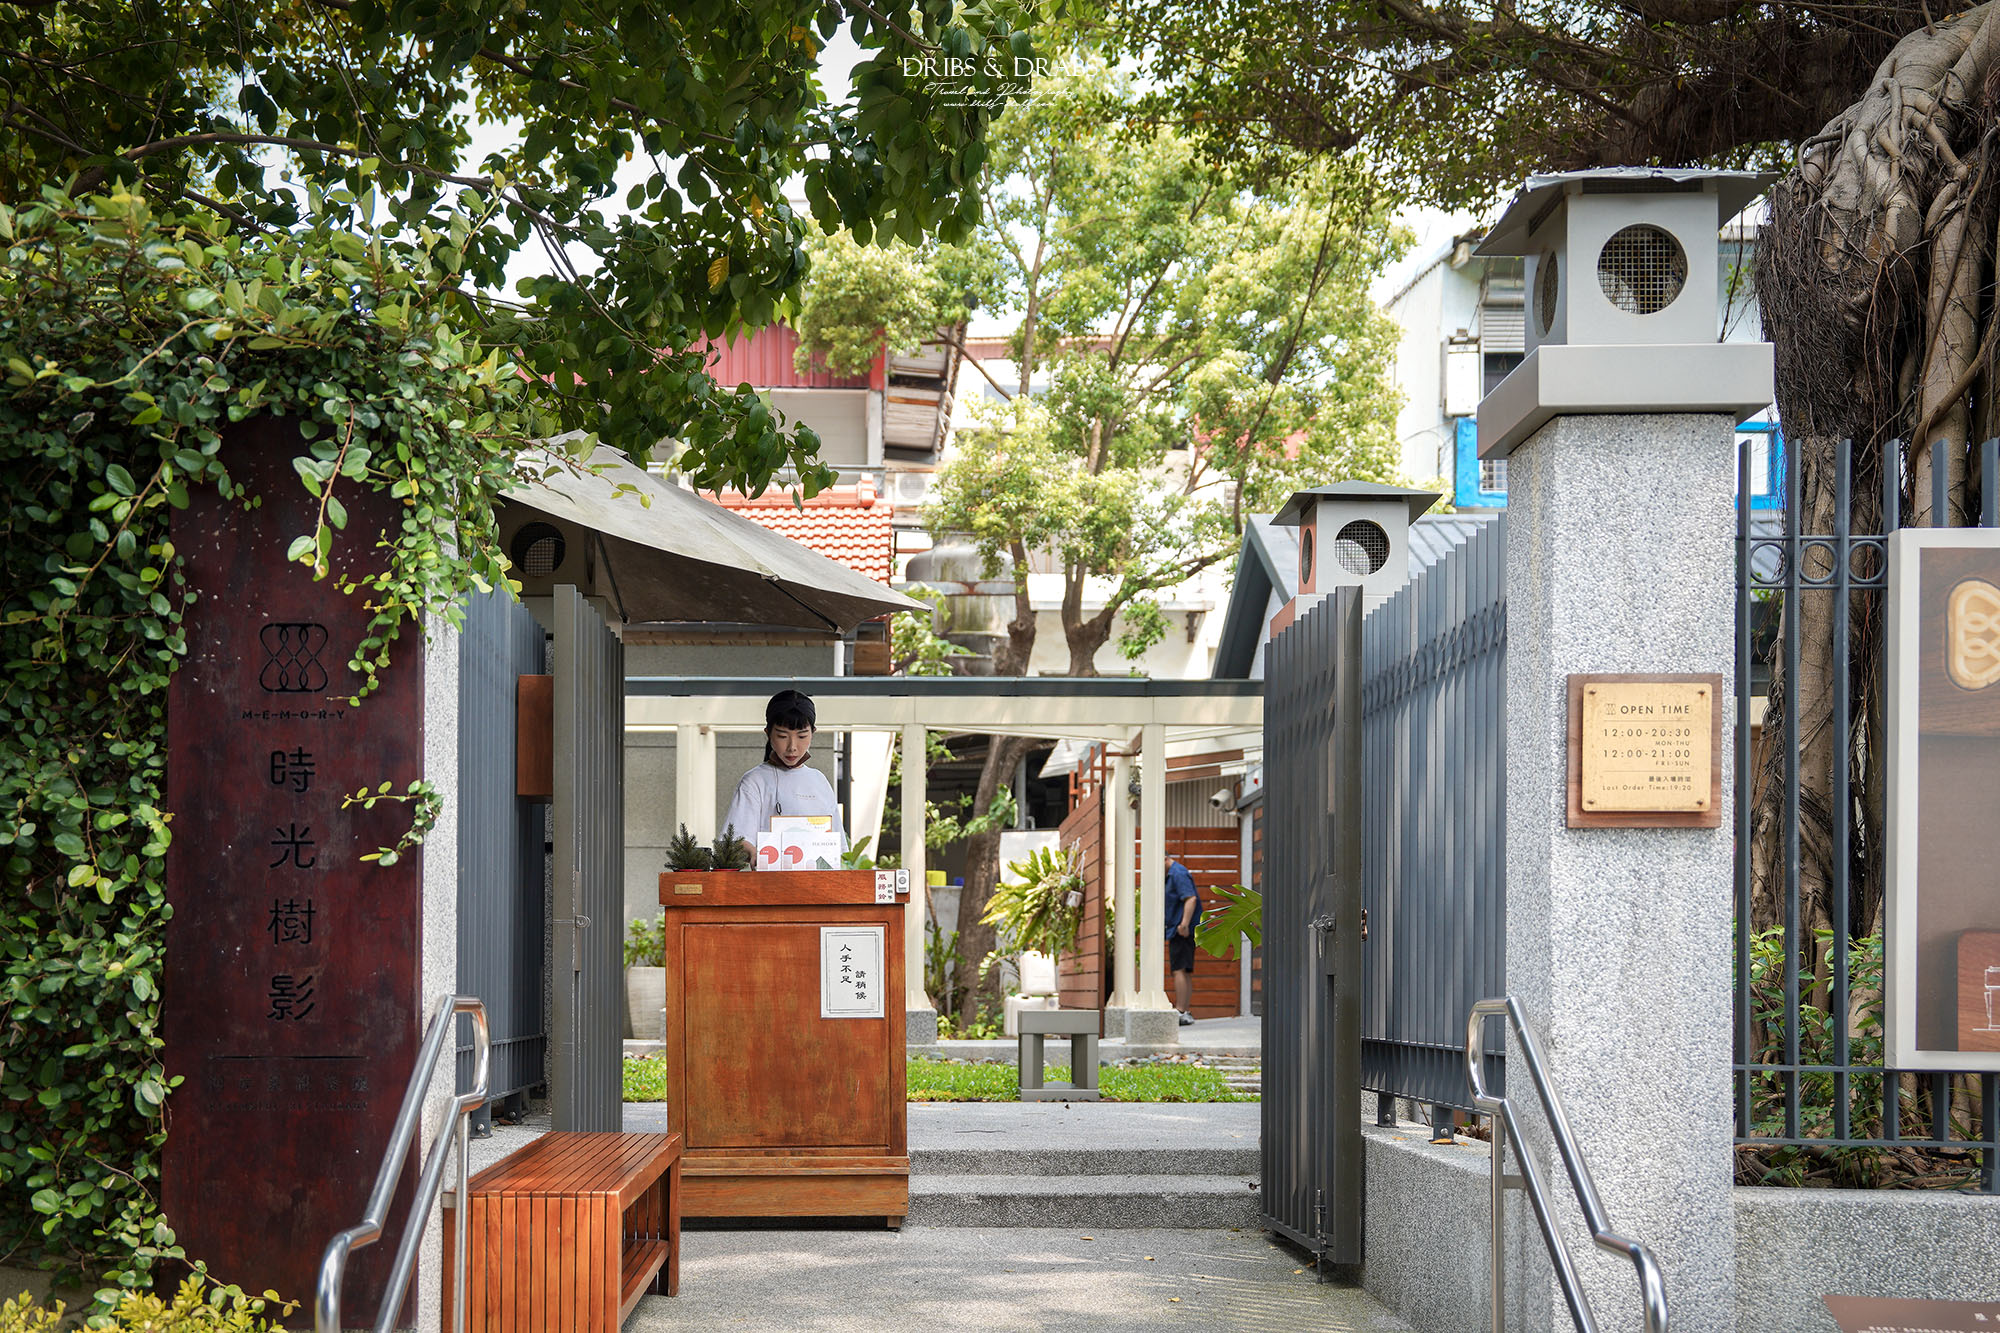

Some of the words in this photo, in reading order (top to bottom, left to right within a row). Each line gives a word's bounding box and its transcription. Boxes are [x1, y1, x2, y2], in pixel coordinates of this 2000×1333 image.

[1620, 705, 1654, 714] OPEN
[1662, 705, 1690, 714] TIME
[242, 710, 345, 720] M-E-M-O-R-Y
[1603, 728, 1691, 737] 12:00-20:30
[1603, 749, 1691, 758] 12:00-21:00
[267, 746, 317, 1021] 時光樹影
[839, 943, 852, 984] 人手不足
[855, 970, 867, 1000] 請稍候
